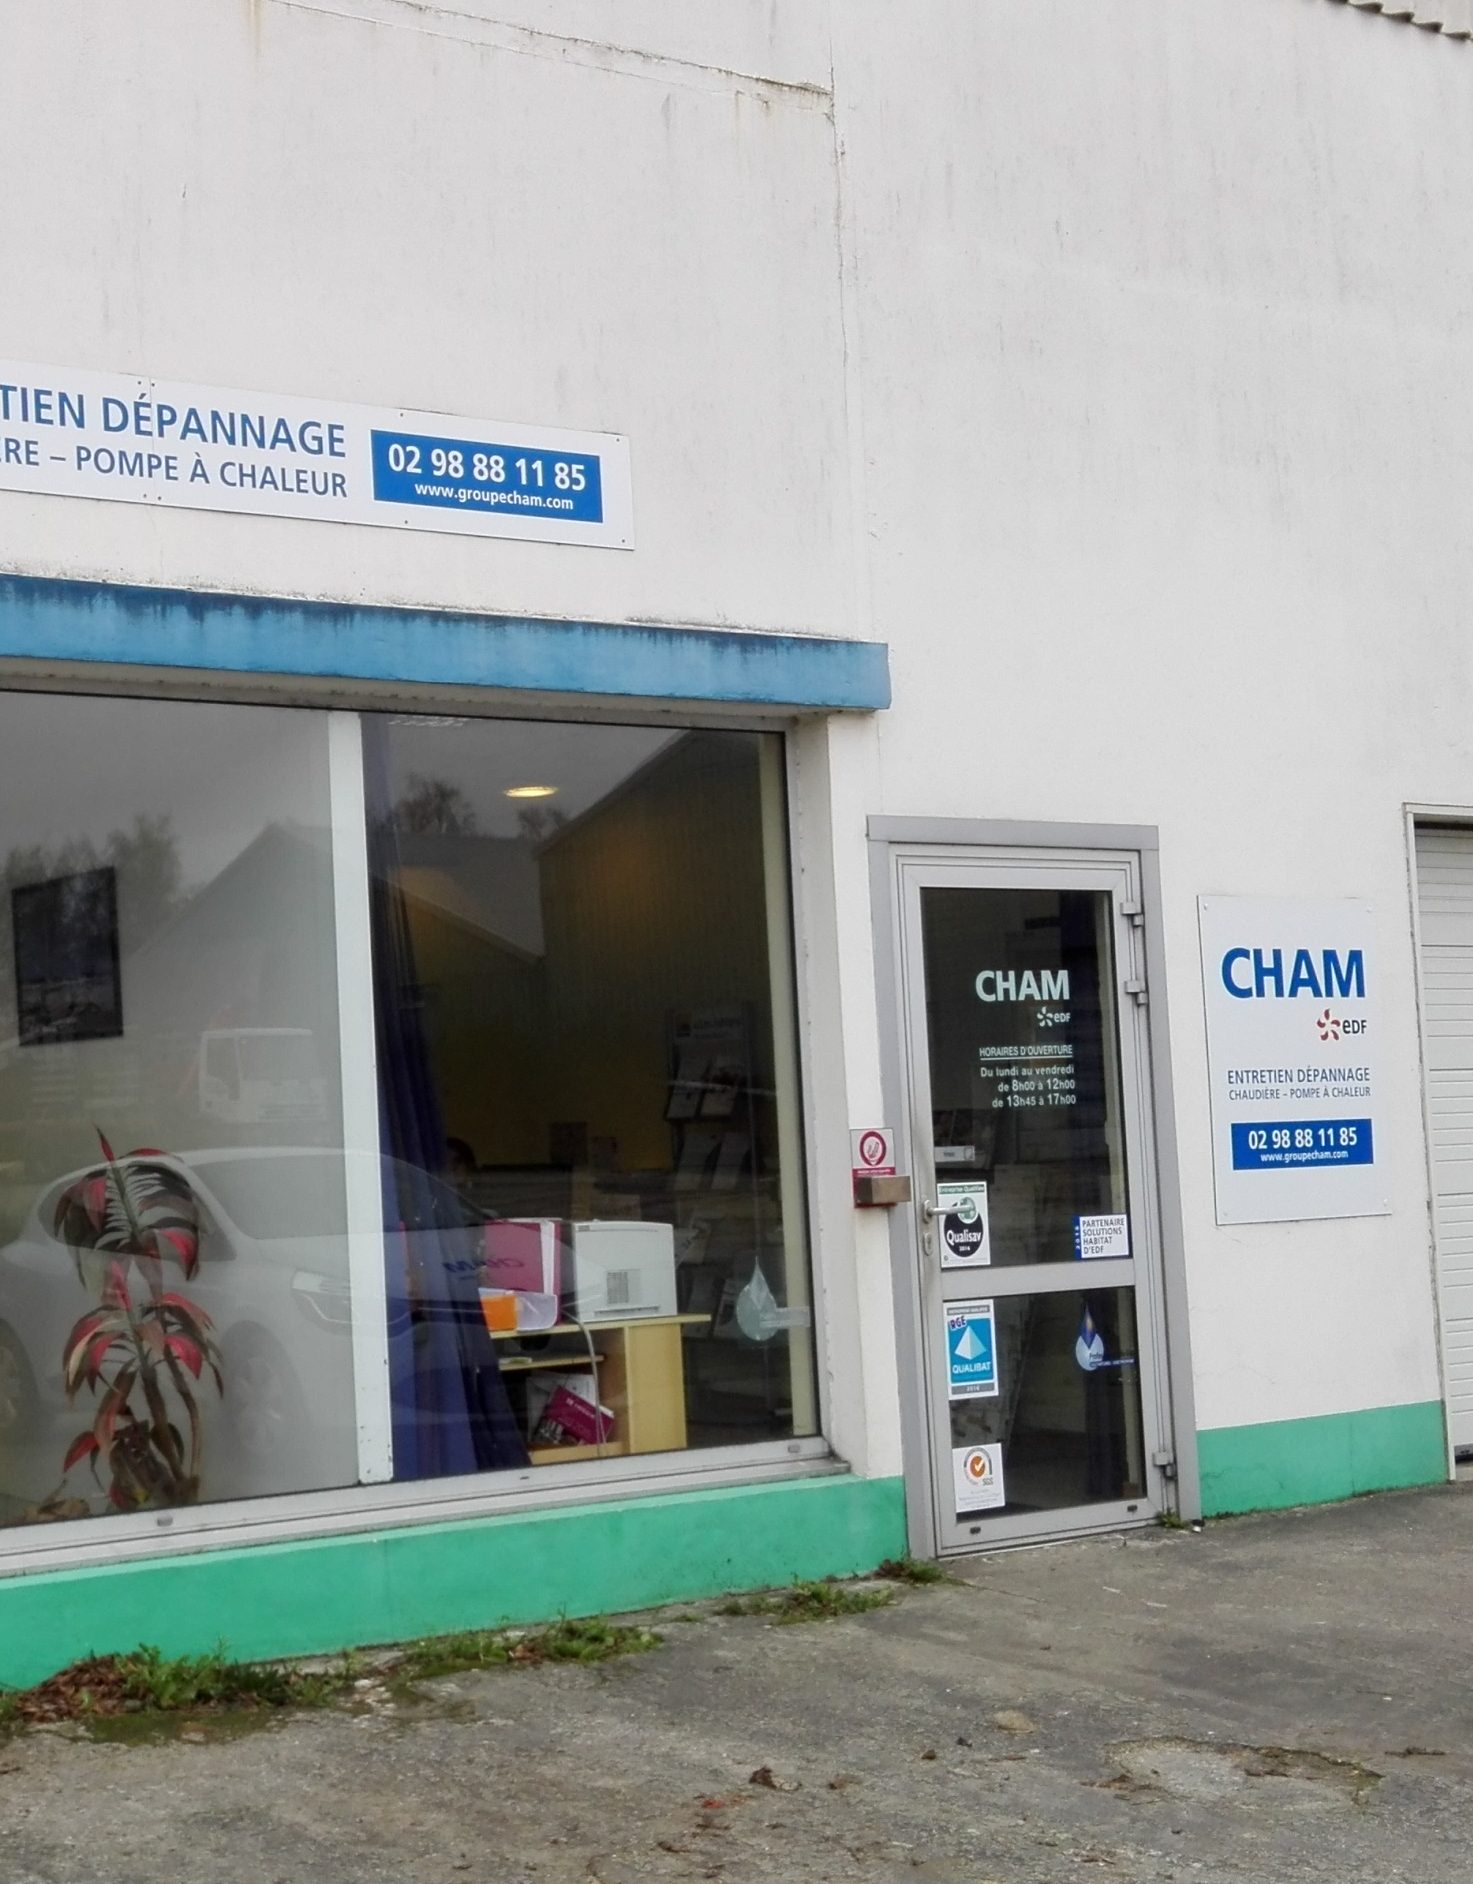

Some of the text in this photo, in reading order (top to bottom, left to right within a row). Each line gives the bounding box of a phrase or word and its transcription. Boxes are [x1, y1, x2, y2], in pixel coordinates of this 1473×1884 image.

[103, 393, 347, 458] DÉPANNAGE
[76, 444, 179, 481] POMPE
[189, 452, 211, 485] À
[222, 461, 348, 498] CHALEUR
[389, 444, 585, 491] 02 98 88 11 85
[415, 482, 574, 510] www.groupecham.com
[1221, 947, 1365, 998] CHAM
[975, 969, 1069, 1002] CHAM
[979, 1044, 1073, 1056] HORAIRES D'OUVERTURE
[981, 1065, 1074, 1076] Du lundi au vendredi
[1228, 1065, 1370, 1085] ENTRETIEN DÉPANNAGE
[998, 1078, 1075, 1092] de 8h00 à 12h00
[1229, 1087, 1280, 1100] CHAUDIÈRE
[1290, 1087, 1320, 1099] POMPE
[1324, 1085, 1330, 1098] À
[1332, 1086, 1371, 1098] CHALEUR
[992, 1093, 1076, 1108] de 13h45 à 17h00
[1248, 1127, 1357, 1149] 02 98 88 11 85
[1261, 1149, 1348, 1163] www.groupecham.com
[1082, 1218, 1124, 1227] PARTENAIRE
[947, 1229, 981, 1245] Qualisav
[1083, 1227, 1122, 1236] SOLUTIONS
[1083, 1237, 1112, 1245] HABITAT
[1084, 1246, 1104, 1254] D'EDF
[950, 1316, 966, 1329] RGE
[952, 1362, 991, 1374] QUALIBAT
